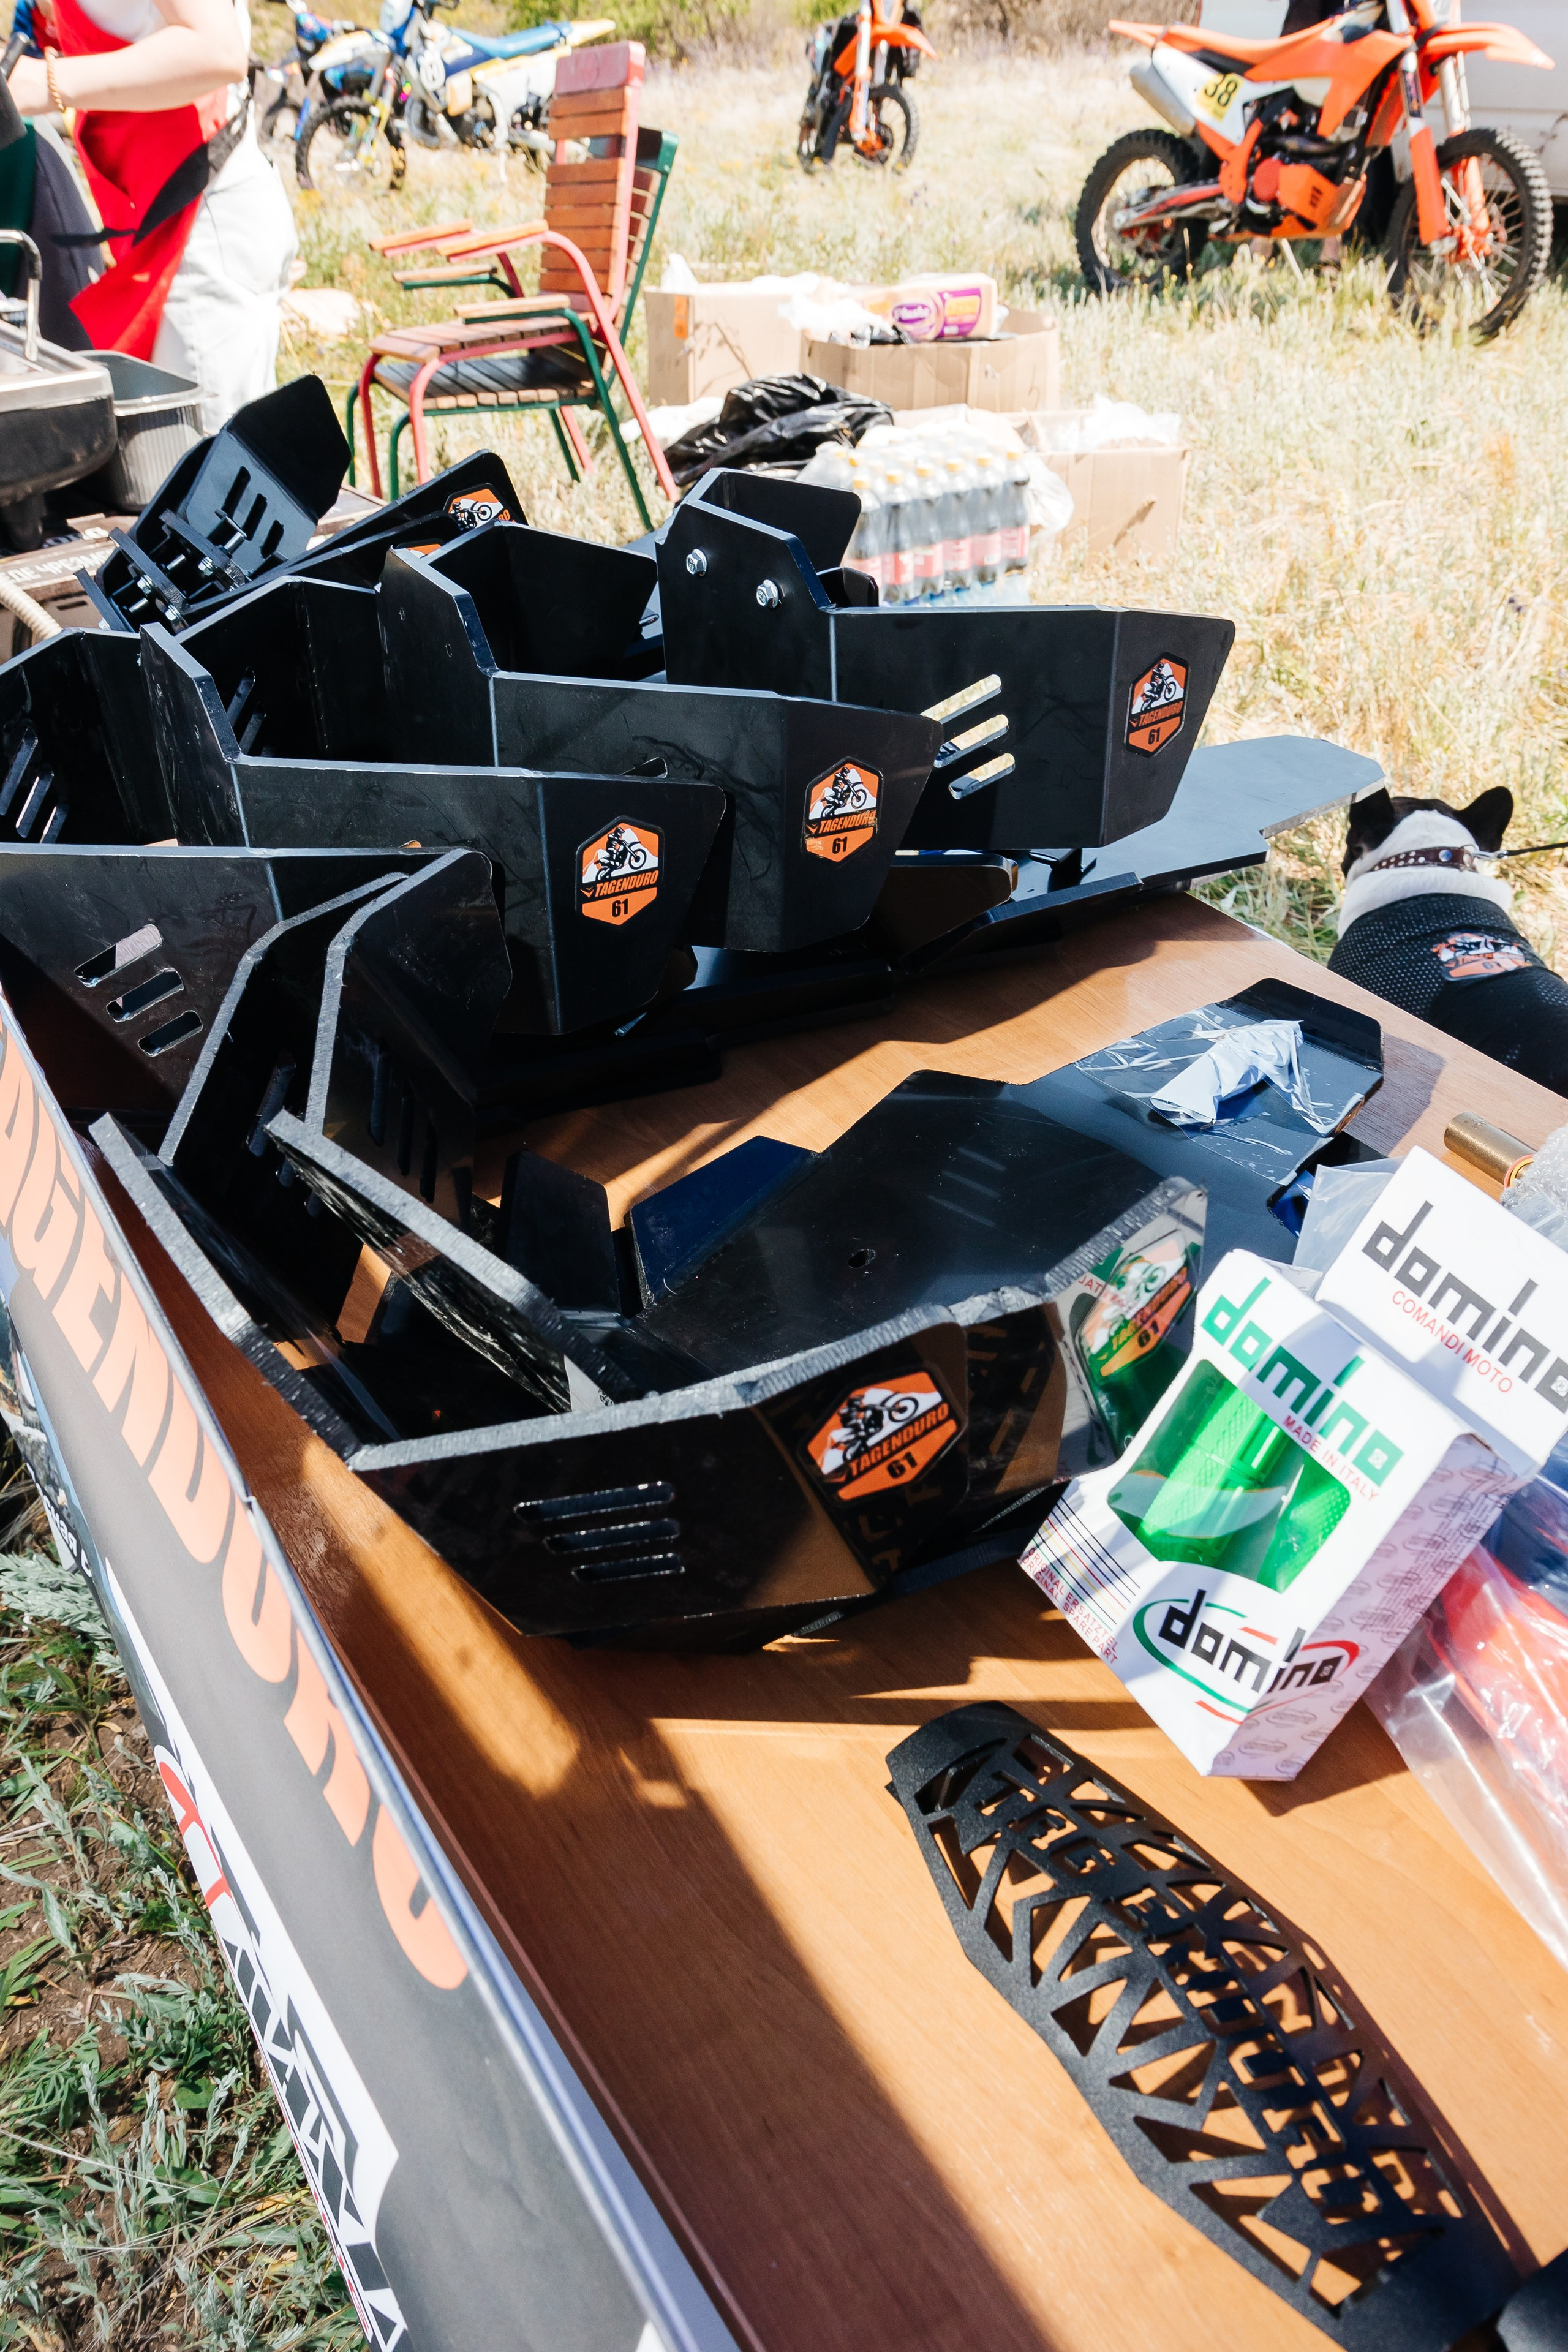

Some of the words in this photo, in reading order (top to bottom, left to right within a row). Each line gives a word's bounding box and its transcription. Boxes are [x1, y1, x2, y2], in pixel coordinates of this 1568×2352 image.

[1148, 727, 1161, 745] 61
[818, 809, 876, 834] TAGENDURO
[832, 836, 848, 854] 61
[595, 870, 659, 897] TAGENDURO
[611, 898, 628, 918] 61
[1392, 1291, 1465, 1355] COMANDI
[1462, 1348, 1513, 1393] MOTO
[1200, 1276, 1404, 1487] domino
[849, 1402, 949, 1477] TAGENDURO
[1283, 1415, 1322, 1453] MADE
[1322, 1449, 1339, 1467] IN
[1339, 1463, 1379, 1501] ITALY
[886, 1452, 918, 1479] 61
[1028, 1547, 1065, 1596] ORIGINAL
[1022, 1555, 1060, 1602] ORIGINAL
[1063, 1602, 1093, 1637] SPARE
[1092, 1636, 1118, 1665] PART
[1158, 1589, 1344, 1694] domino
